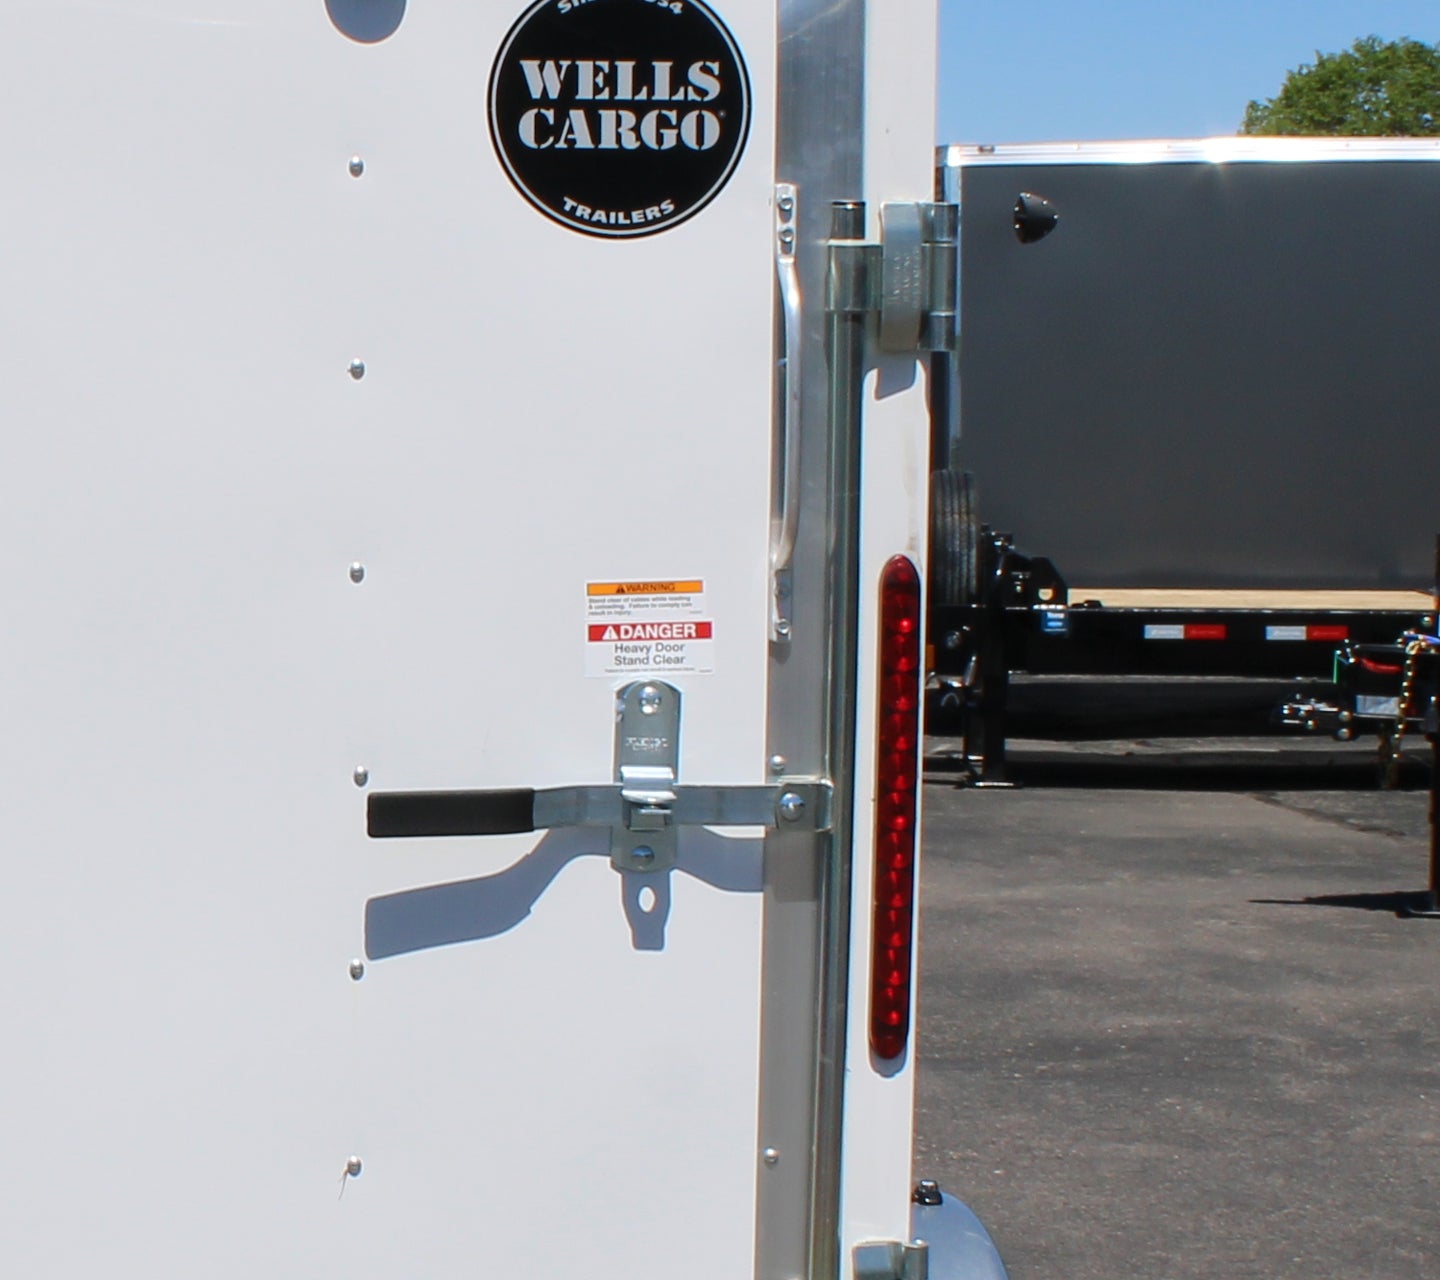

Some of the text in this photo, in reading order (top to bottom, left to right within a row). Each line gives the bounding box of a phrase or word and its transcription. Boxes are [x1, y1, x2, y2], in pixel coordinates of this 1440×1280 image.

[520, 59, 721, 102] WELLS
[518, 108, 721, 150] CARGO
[563, 197, 675, 224] TRAILERS
[626, 583, 675, 592] WARNING
[620, 624, 697, 639] DANGER
[614, 642, 685, 655] Heavy Door
[614, 655, 685, 666] Stand Clear
